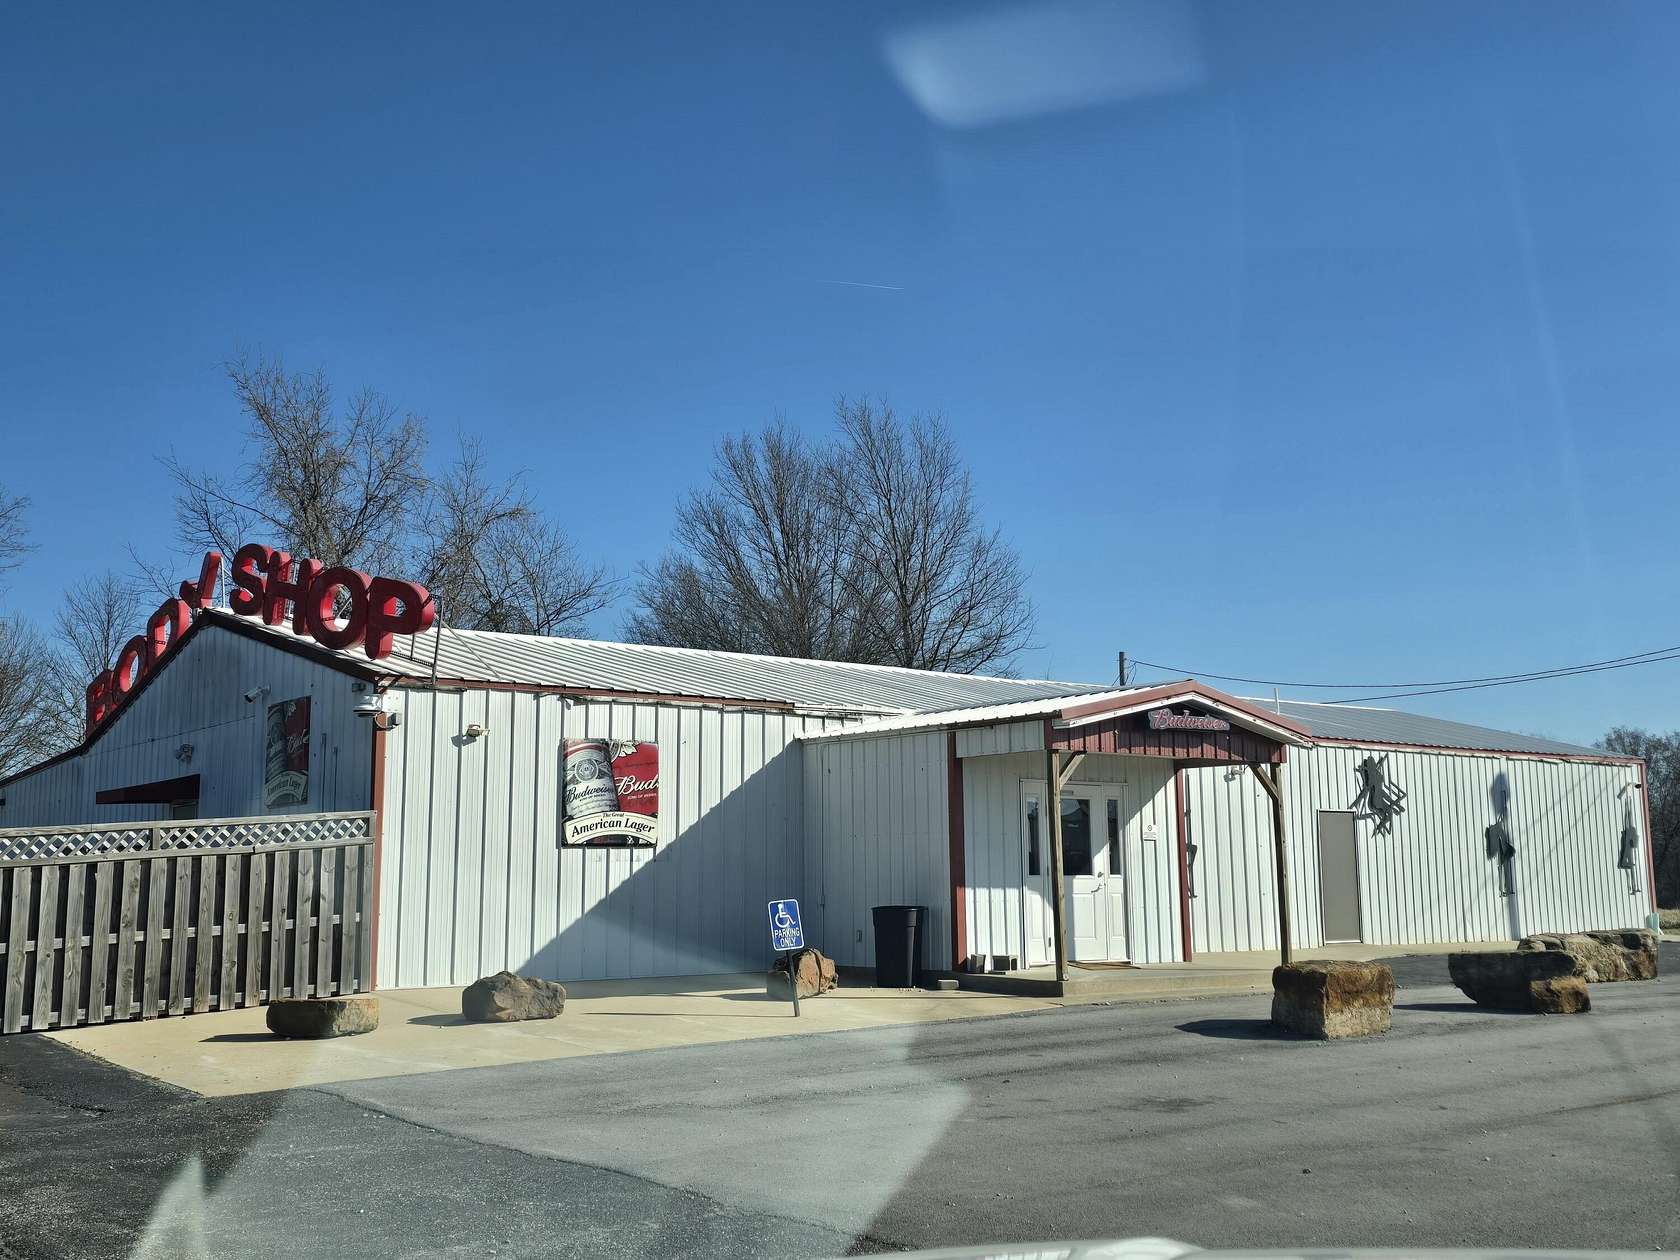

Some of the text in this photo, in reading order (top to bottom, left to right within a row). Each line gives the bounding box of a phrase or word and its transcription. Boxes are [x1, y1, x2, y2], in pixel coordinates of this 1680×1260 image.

[229, 543, 435, 659] SHOP
[1148, 708, 1230, 730] Budweiser
[571, 818, 655, 837] American Lager
[774, 927, 800, 938] PARKING
[780, 937, 796, 947] ONLY
